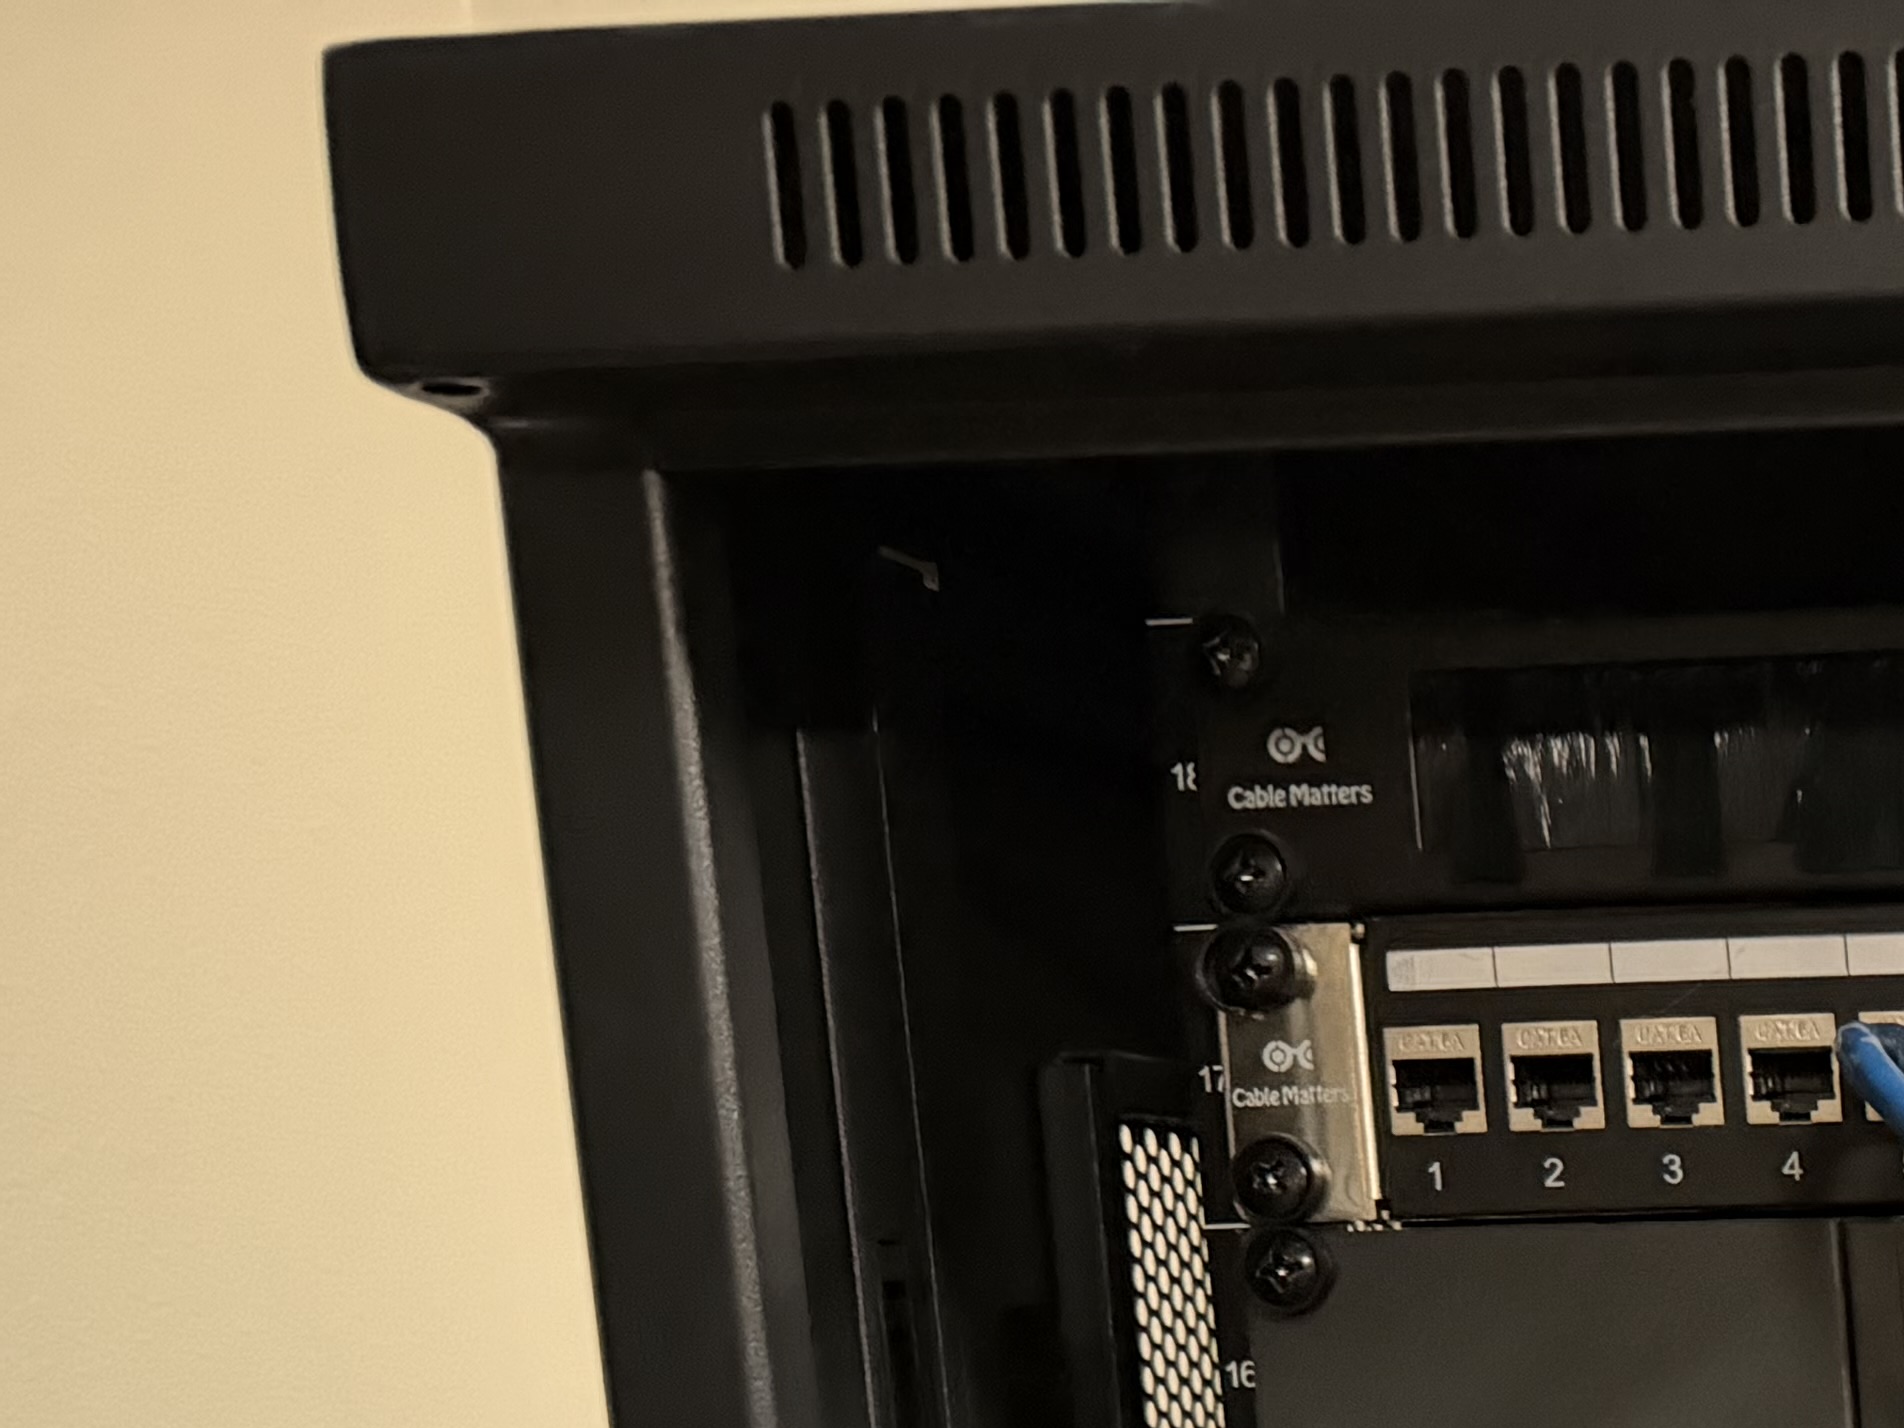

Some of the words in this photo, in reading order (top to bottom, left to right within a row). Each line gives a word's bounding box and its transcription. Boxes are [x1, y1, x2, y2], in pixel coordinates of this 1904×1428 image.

[1228, 784, 1284, 810] Cable
[1289, 781, 1374, 808] Matters
[1232, 1087, 1277, 1109] Cable
[1281, 1083, 1349, 1105] Matters
[1428, 1162, 1443, 1191] 1
[1544, 1158, 1564, 1189] 2
[1662, 1155, 1684, 1185] 3
[1782, 1152, 1804, 1180] 4
[1225, 1360, 1256, 1389] 16
